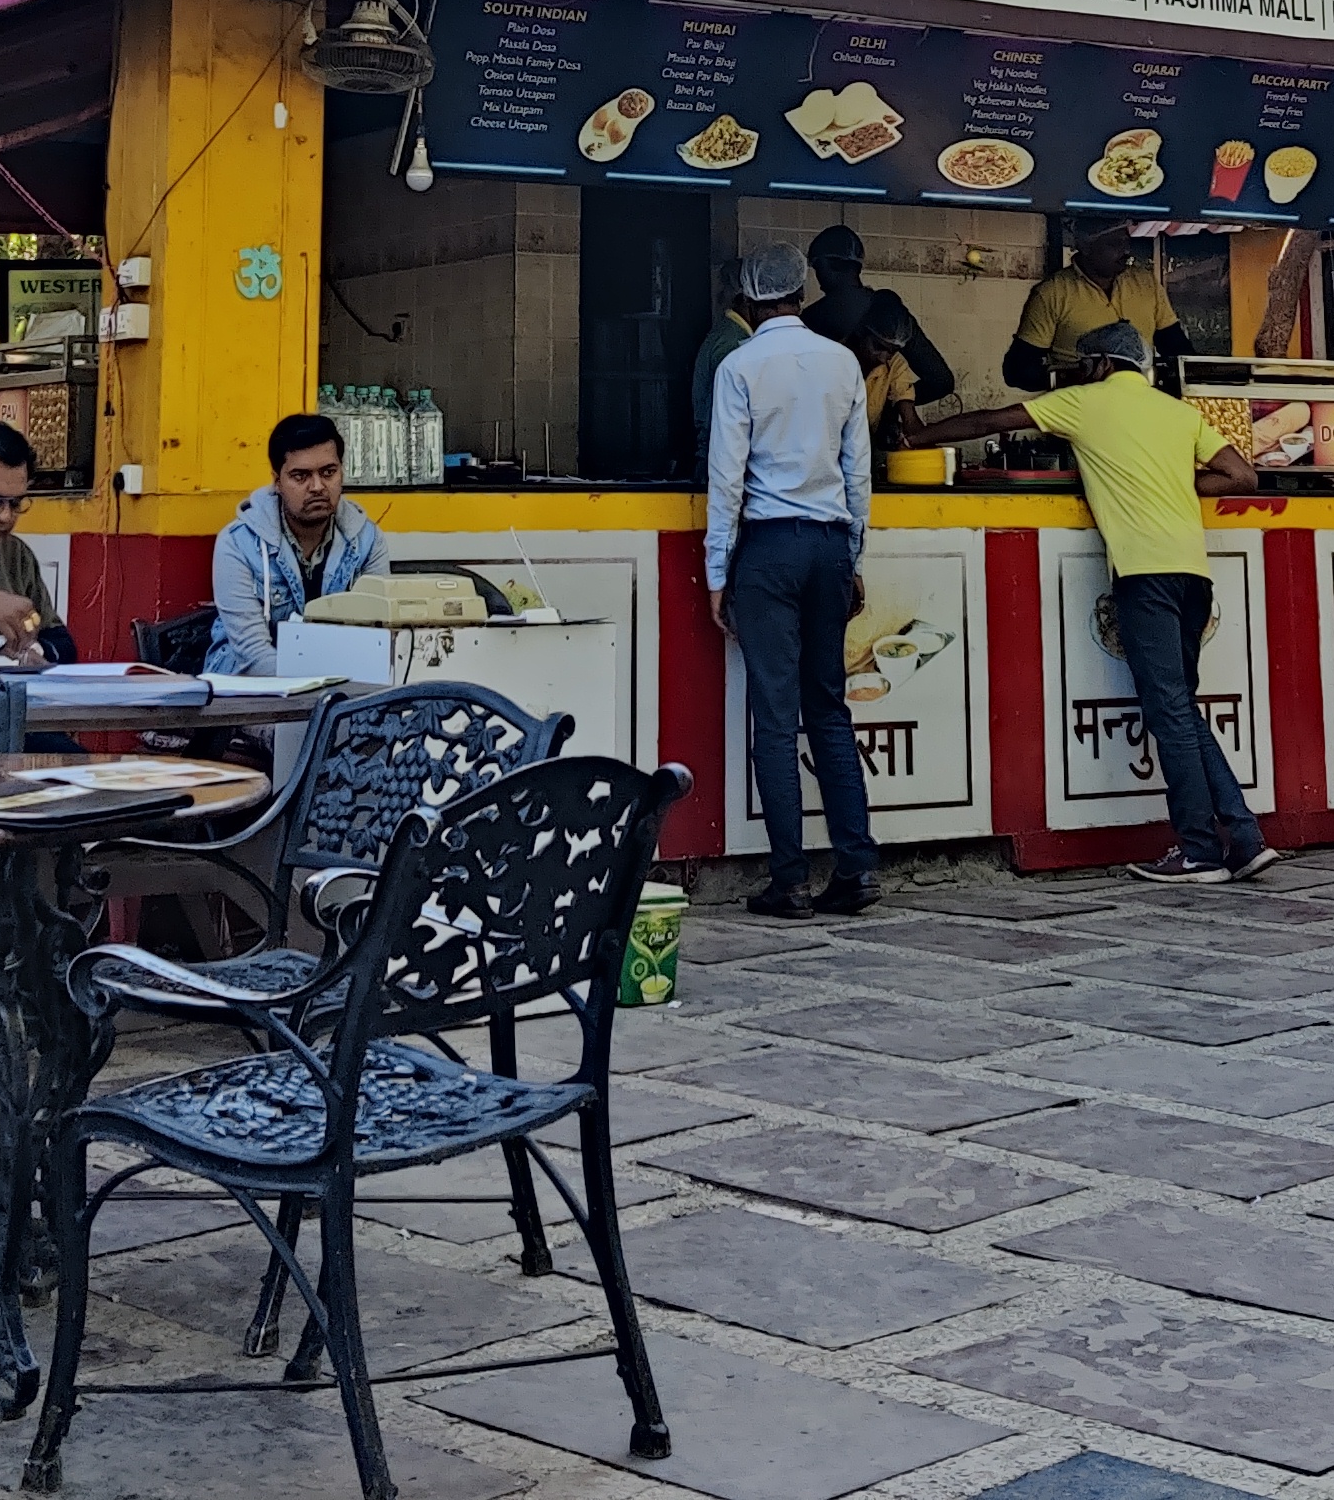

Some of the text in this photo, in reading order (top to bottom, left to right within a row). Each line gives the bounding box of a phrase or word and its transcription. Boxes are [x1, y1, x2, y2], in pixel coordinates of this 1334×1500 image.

[483, 1, 588, 22] SOUTH INDIAN
[683, 21, 736, 36] MUMBAI
[850, 36, 887, 50] DELHI
[993, 50, 1044, 65] CHINESE
[1132, 63, 1182, 77] GUJARAT
[1251, 74, 1331, 92] BACCHA PARTY
